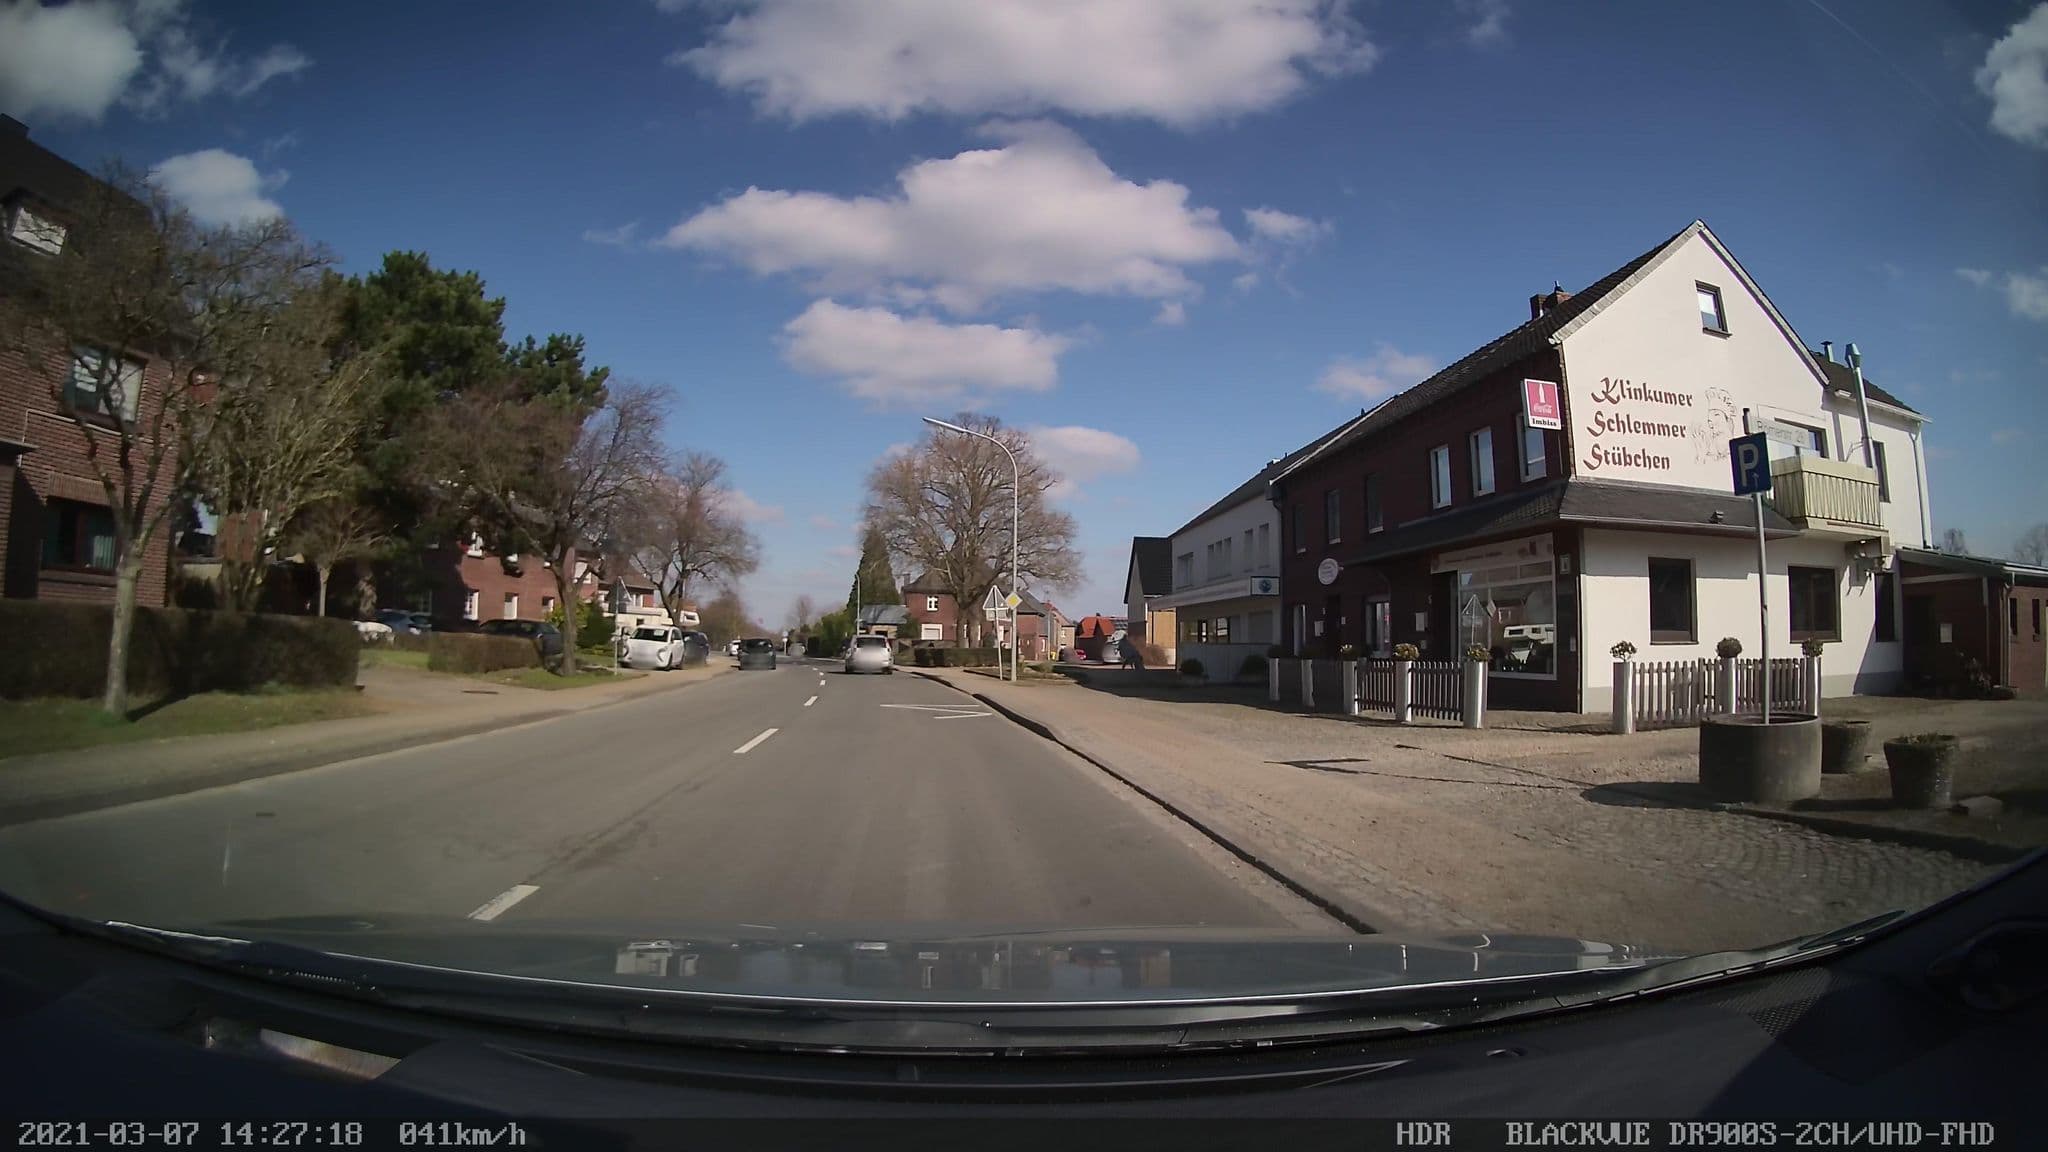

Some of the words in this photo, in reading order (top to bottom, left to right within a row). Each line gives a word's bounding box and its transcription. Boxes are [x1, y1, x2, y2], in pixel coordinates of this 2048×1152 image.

[1591, 377, 1692, 407] Klinkumer
[1532, 418, 1557, 427] Imbiss
[1586, 410, 1686, 438] Schlemmer
[1583, 443, 1670, 470] Stübchen
[1737, 443, 1759, 487] P
